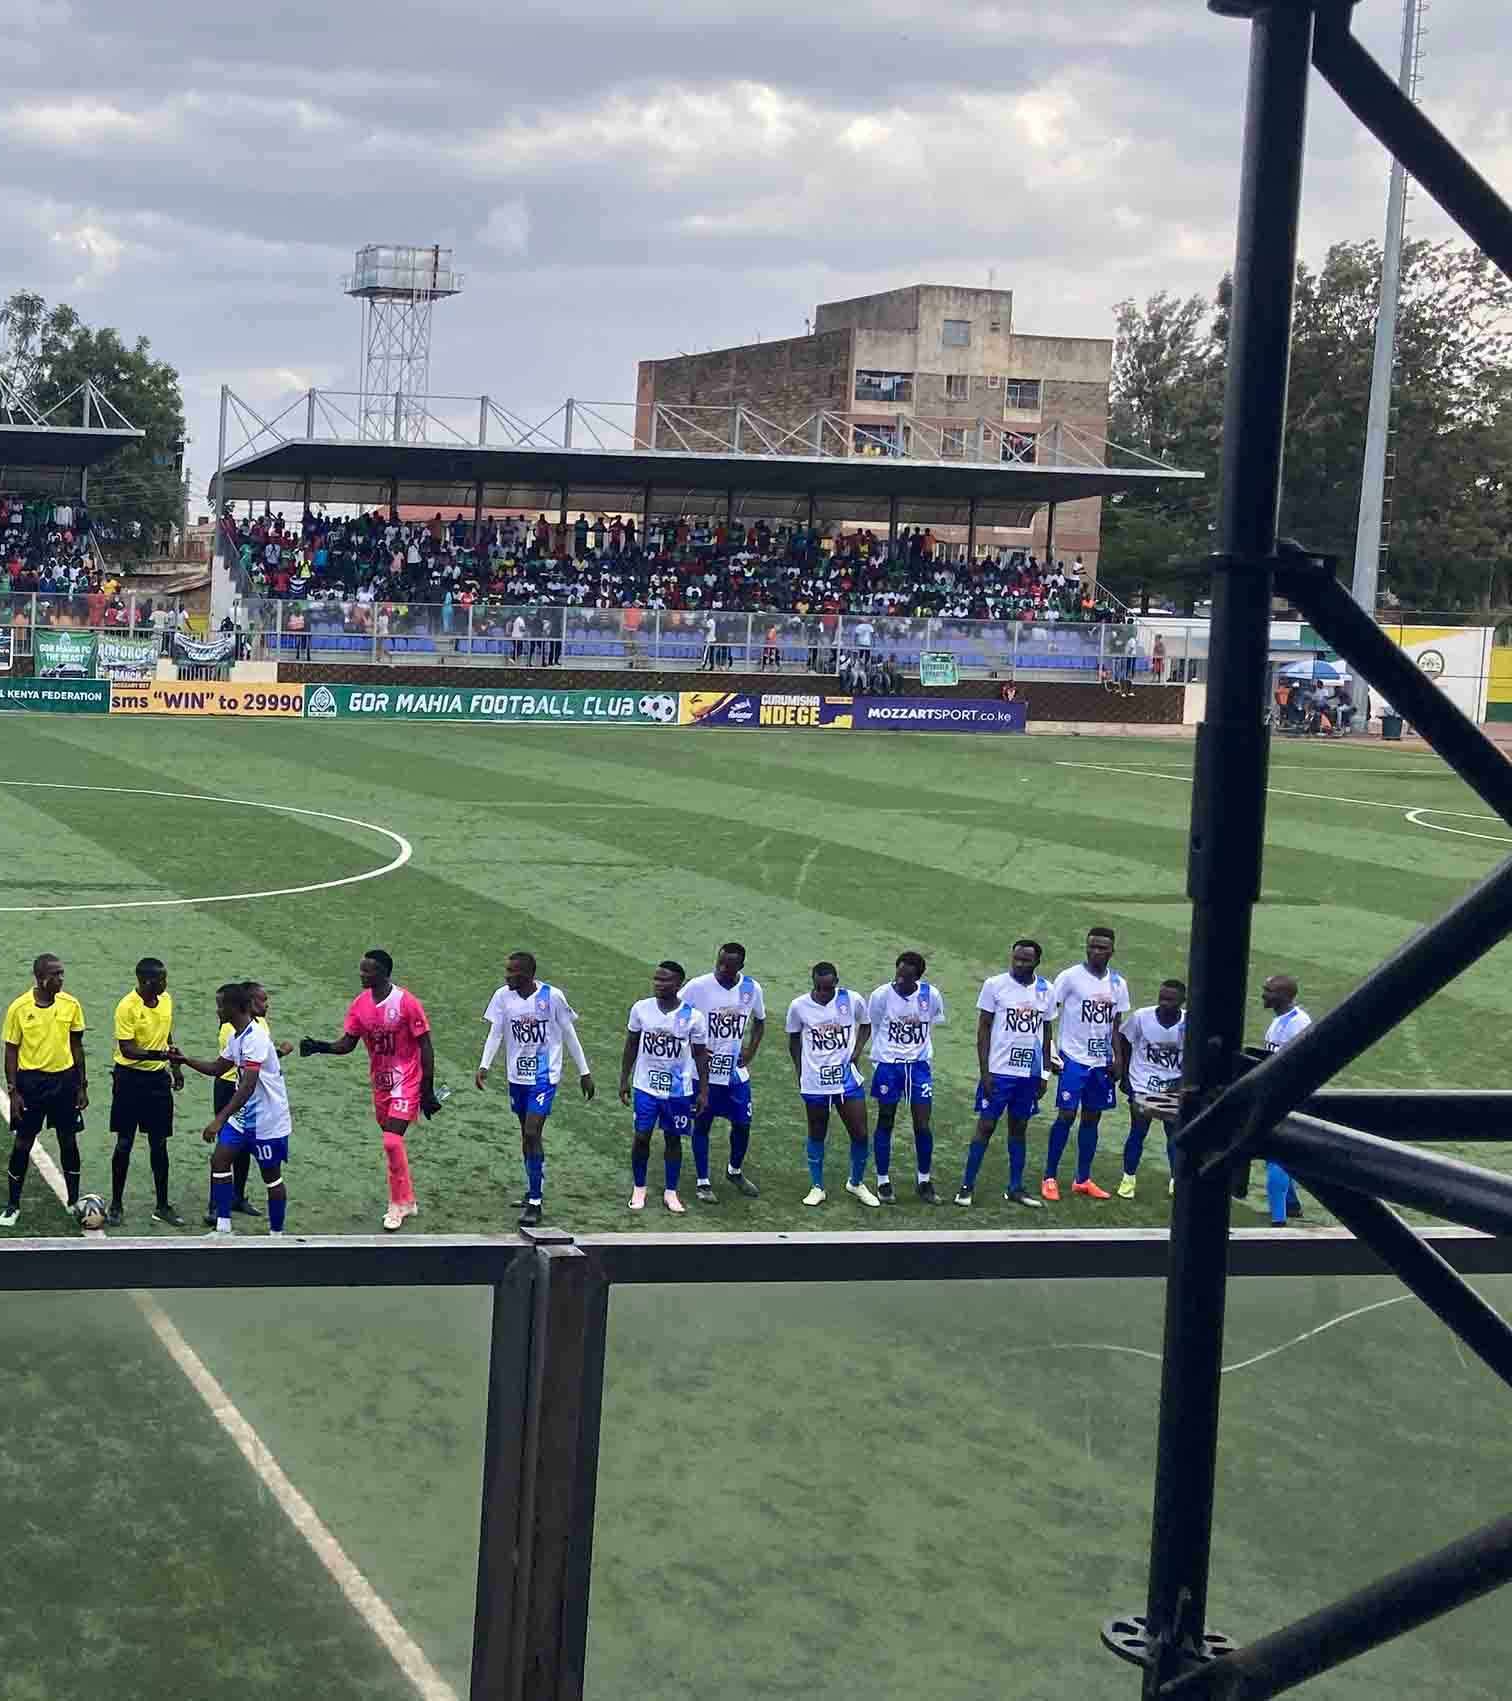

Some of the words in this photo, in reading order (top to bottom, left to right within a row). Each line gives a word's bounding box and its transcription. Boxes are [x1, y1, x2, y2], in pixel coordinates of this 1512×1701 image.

[7, 688, 40, 700] KENYA
[41, 690, 103, 702] FEDERATION
[112, 695, 149, 709] sms
[219, 695, 237, 710] to
[243, 692, 304, 712] 29990
[349, 692, 390, 711] GOR
[394, 693, 463, 713] MAHIA
[466, 694, 575, 715] FOOTBALL
[583, 697, 634, 715] CLUB
[759, 705, 821, 726] NDEGE
[867, 706, 1012, 723] MOZZARTSPORT.co.ke
[511, 1019, 549, 1032] RIGHT
[708, 1012, 748, 1027] RIGHT
[512, 1027, 547, 1044] NOW
[708, 1024, 745, 1040] NOW
[812, 1024, 852, 1040] RIGHT
[889, 1021, 928, 1036] RIGHT
[643, 1031, 687, 1046] RIGHT
[812, 1038, 848, 1051] NOW
[888, 1033, 927, 1045] NOW
[642, 1041, 682, 1058] NOW
[674, 1114, 688, 1129] 29
[255, 1144, 273, 1160] 10
